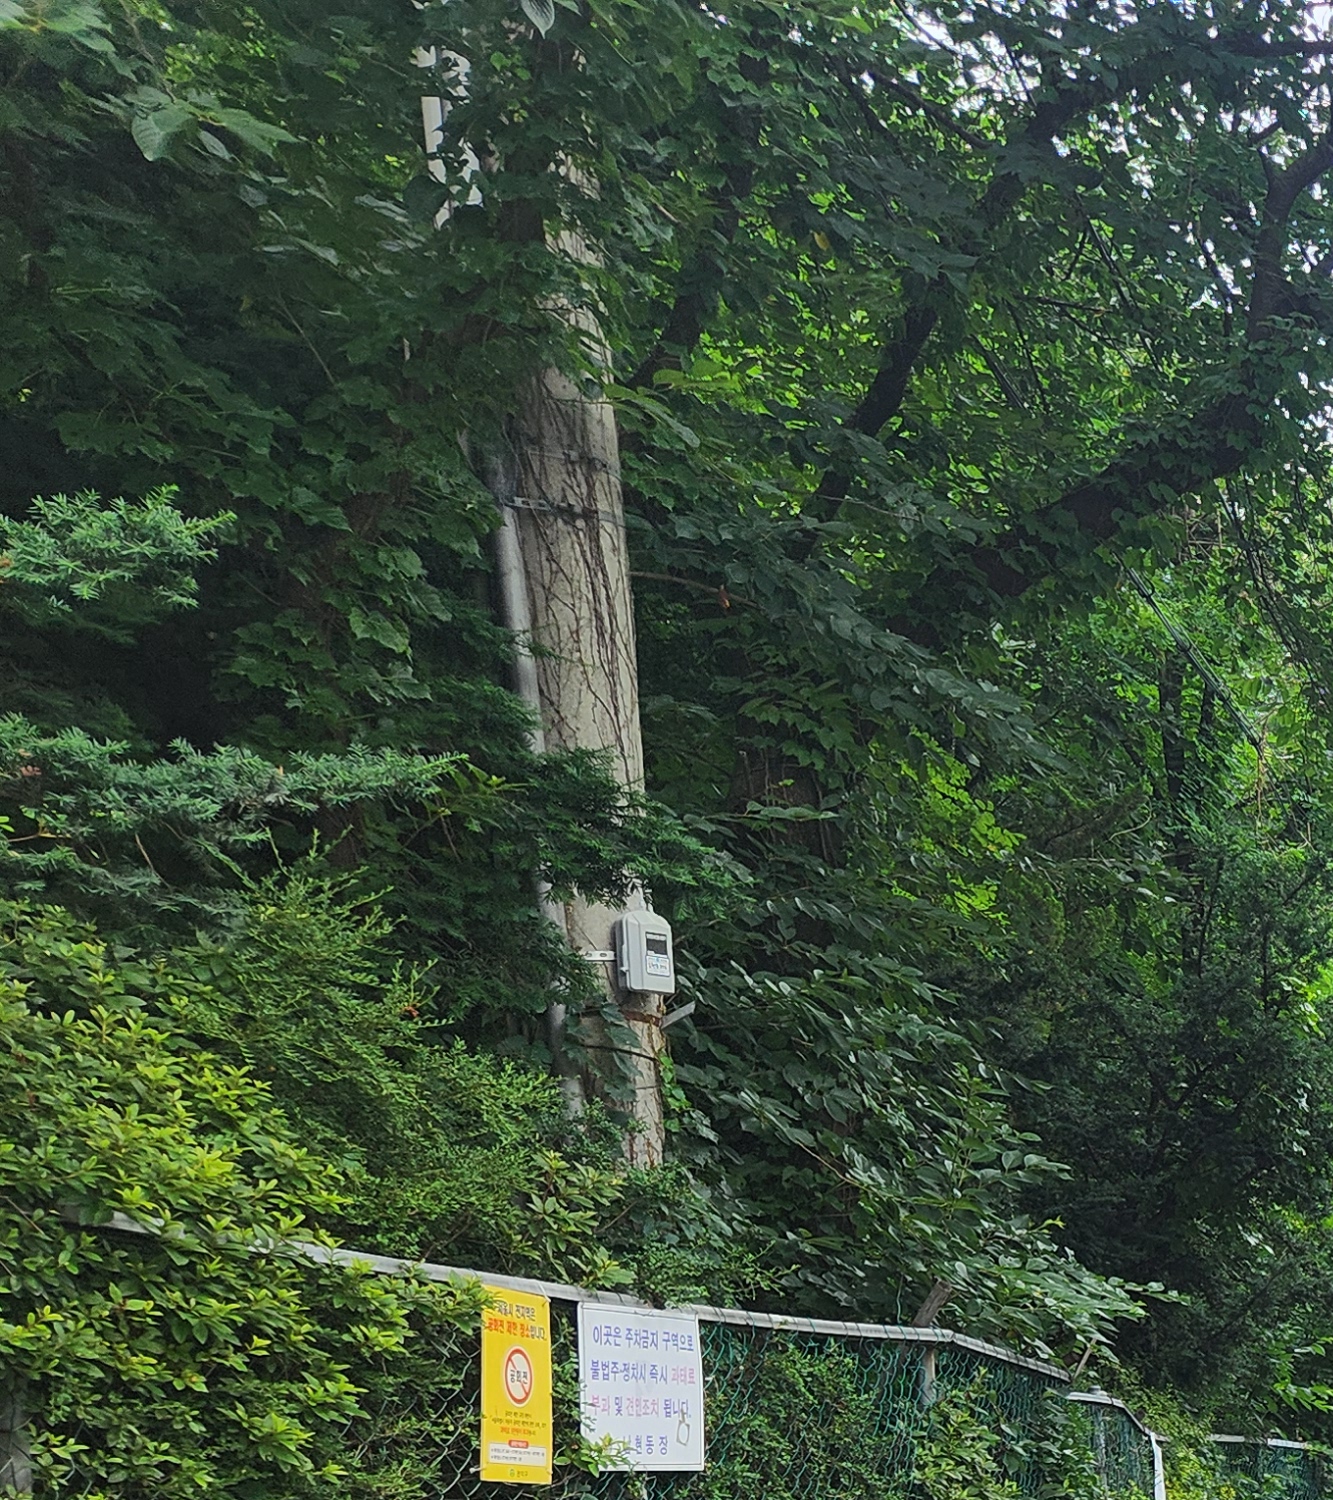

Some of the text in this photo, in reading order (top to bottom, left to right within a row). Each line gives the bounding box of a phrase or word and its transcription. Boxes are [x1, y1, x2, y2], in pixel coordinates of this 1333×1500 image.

[593, 1324, 694, 1352] 이곳은 주차금지 구역으로
[510, 1369, 528, 1385] 공회전
[649, 1364, 668, 1384] 즉시
[671, 1365, 696, 1385] 과태료
[591, 1394, 610, 1416] 부과
[614, 1396, 623, 1416] 및
[626, 1396, 660, 1417] 견인조치
